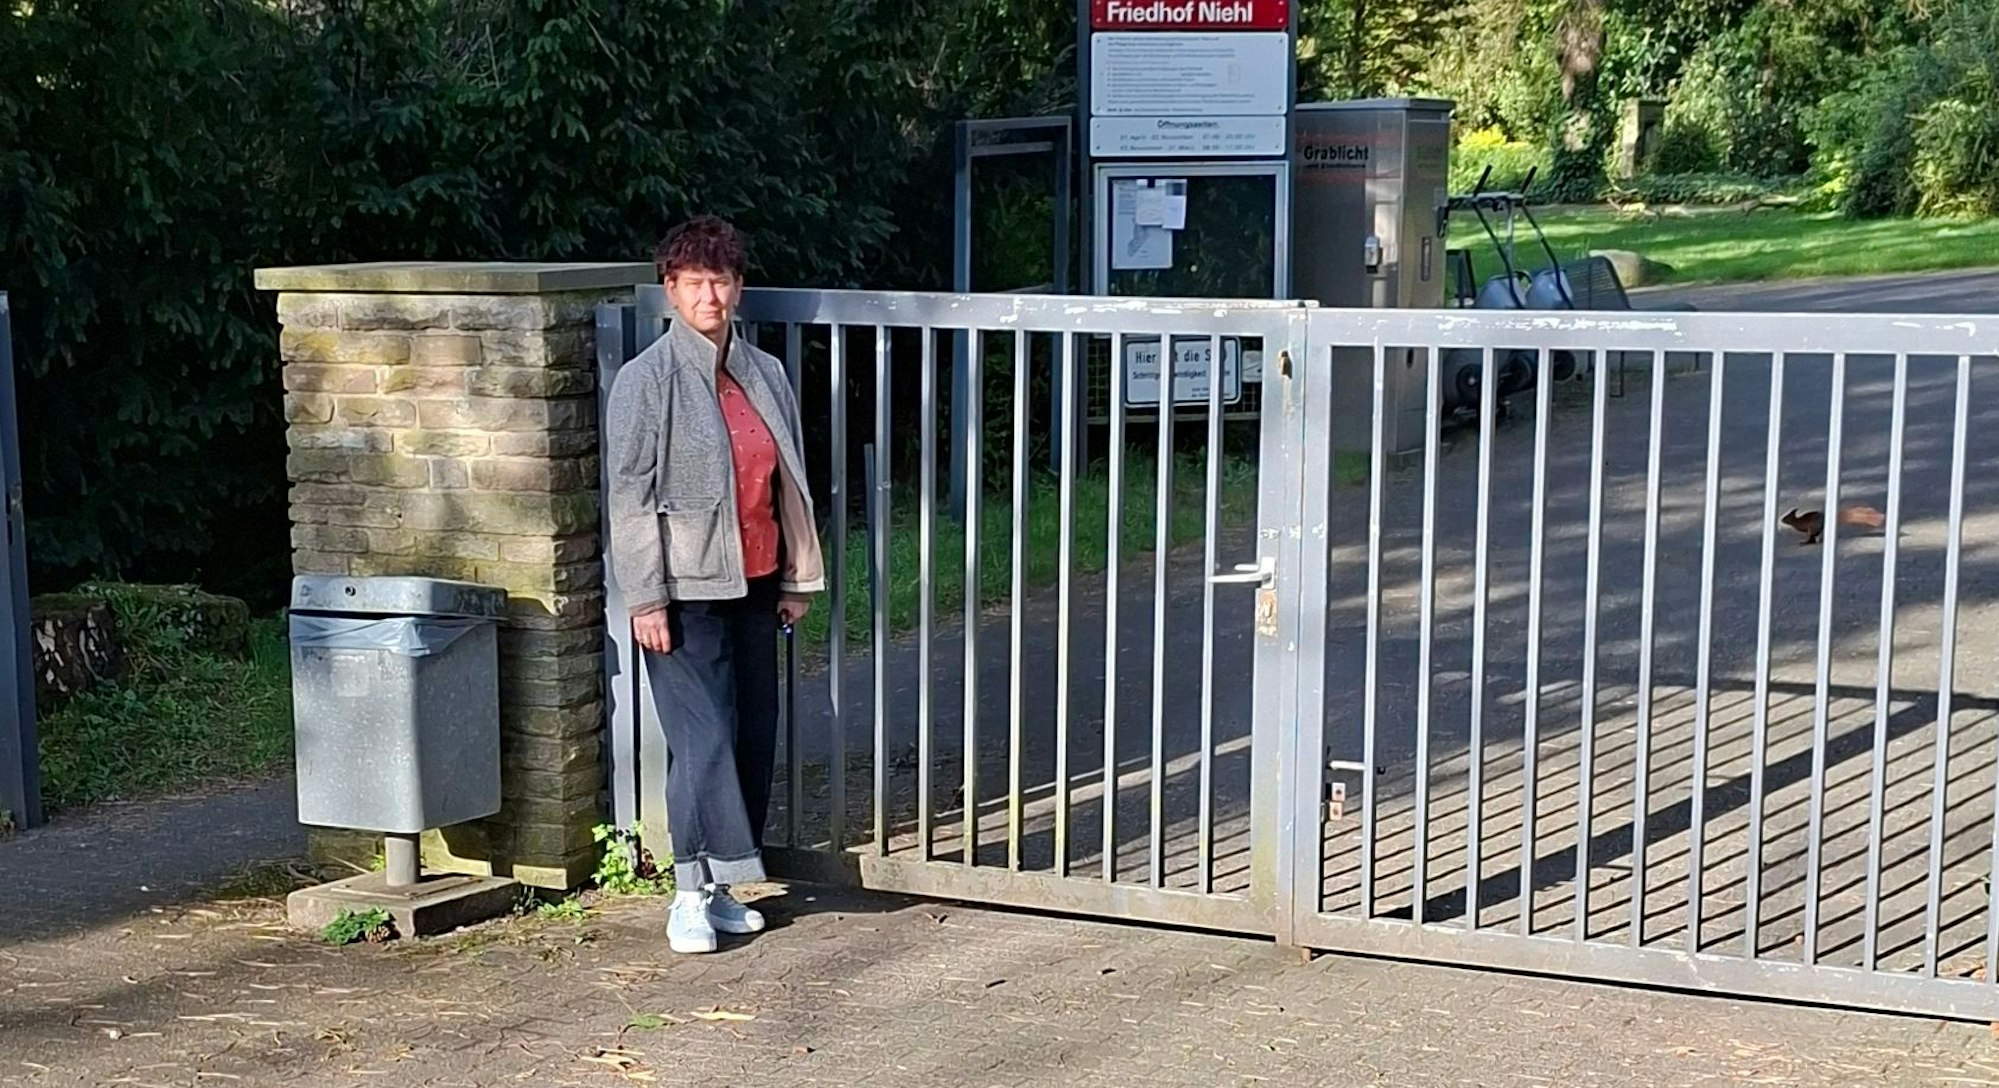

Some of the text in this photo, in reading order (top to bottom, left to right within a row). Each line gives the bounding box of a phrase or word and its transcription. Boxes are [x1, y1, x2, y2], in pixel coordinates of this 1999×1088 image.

[1107, 0, 1253, 22] Friedhof Niehl
[1303, 144, 1369, 160] Grablicht
[1135, 351, 1157, 363] Hier
[1184, 350, 1200, 362] die
